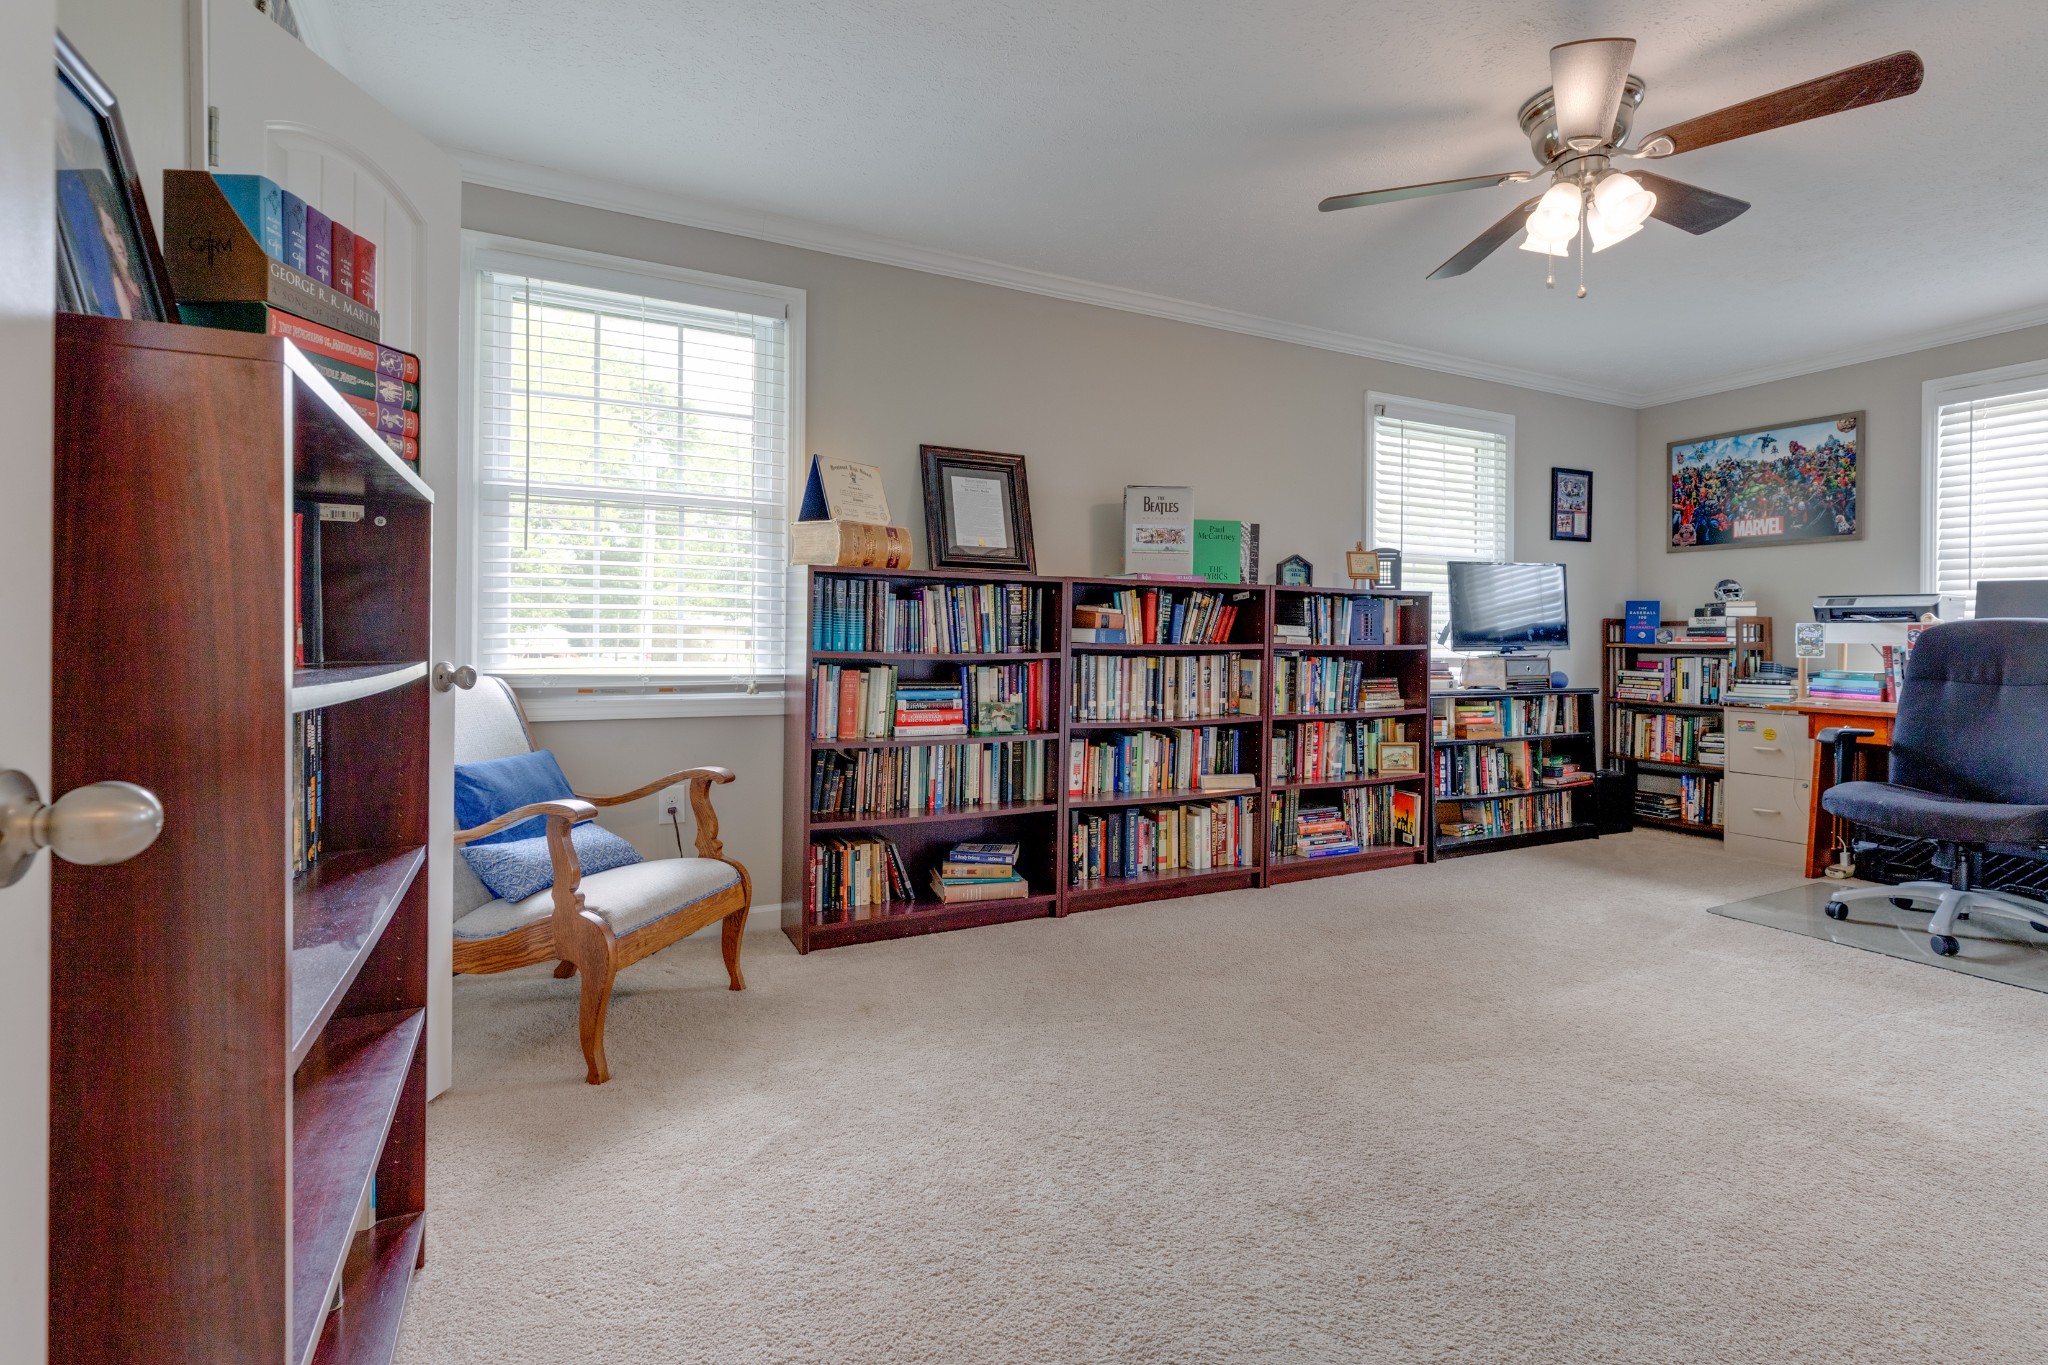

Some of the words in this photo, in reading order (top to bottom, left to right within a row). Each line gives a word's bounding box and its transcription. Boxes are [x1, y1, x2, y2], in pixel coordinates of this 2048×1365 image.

[270, 263, 316, 296] GEORGE
[318, 287, 328, 303] R.
[331, 293, 340, 309] R.
[343, 301, 380, 329] MARTIN
[1143, 496, 1179, 515] BEATLES
[1209, 525, 1225, 533] Paul
[1733, 517, 1782, 538] MARVEL
[1198, 532, 1236, 543] McCartney
[1208, 565, 1223, 573] THE
[1204, 572, 1228, 581] LYRICS
